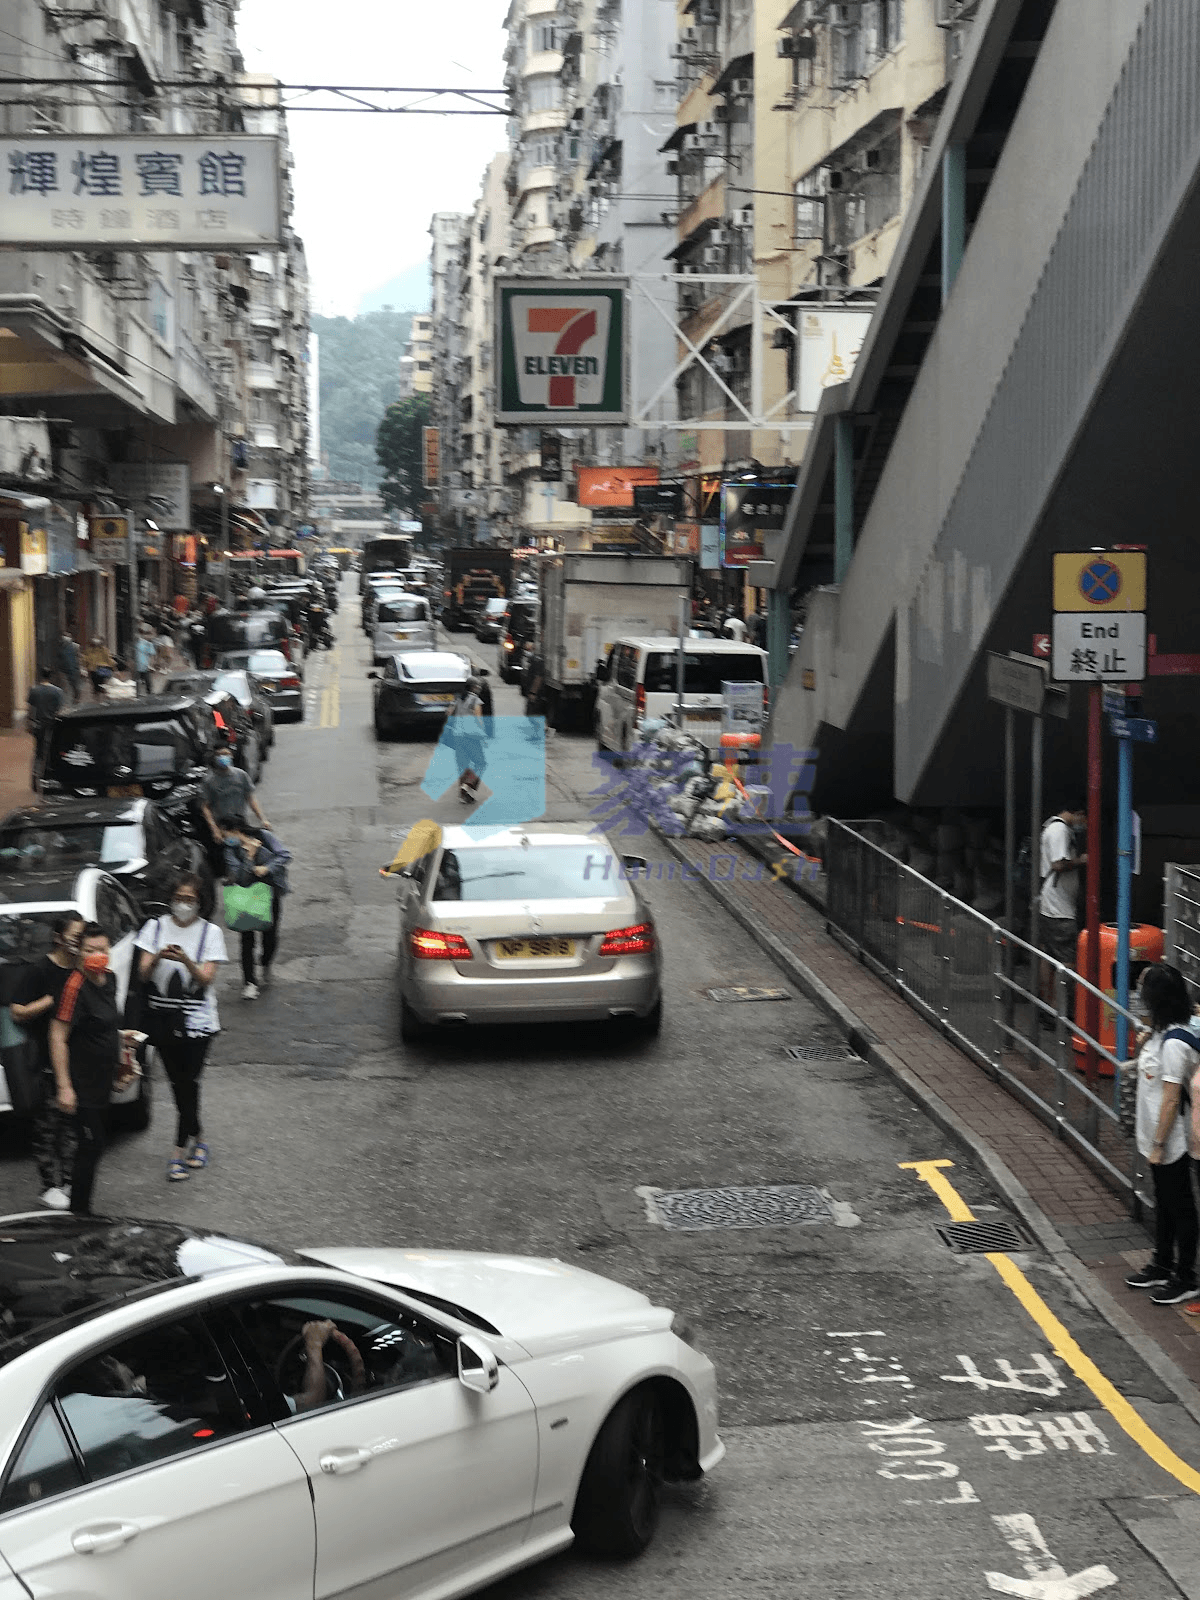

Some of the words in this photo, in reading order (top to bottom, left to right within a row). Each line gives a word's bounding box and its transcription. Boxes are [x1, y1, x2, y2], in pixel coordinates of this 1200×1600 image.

[7, 150, 247, 197] 輝煌賓館
[50, 208, 230, 230] 時鐘酒店
[527, 307, 597, 406] 7
[1081, 622, 1119, 639] End
[1069, 648, 1128, 674] 終止
[939, 1353, 1118, 1461] 望左
[856, 1411, 982, 1505] LOOK
